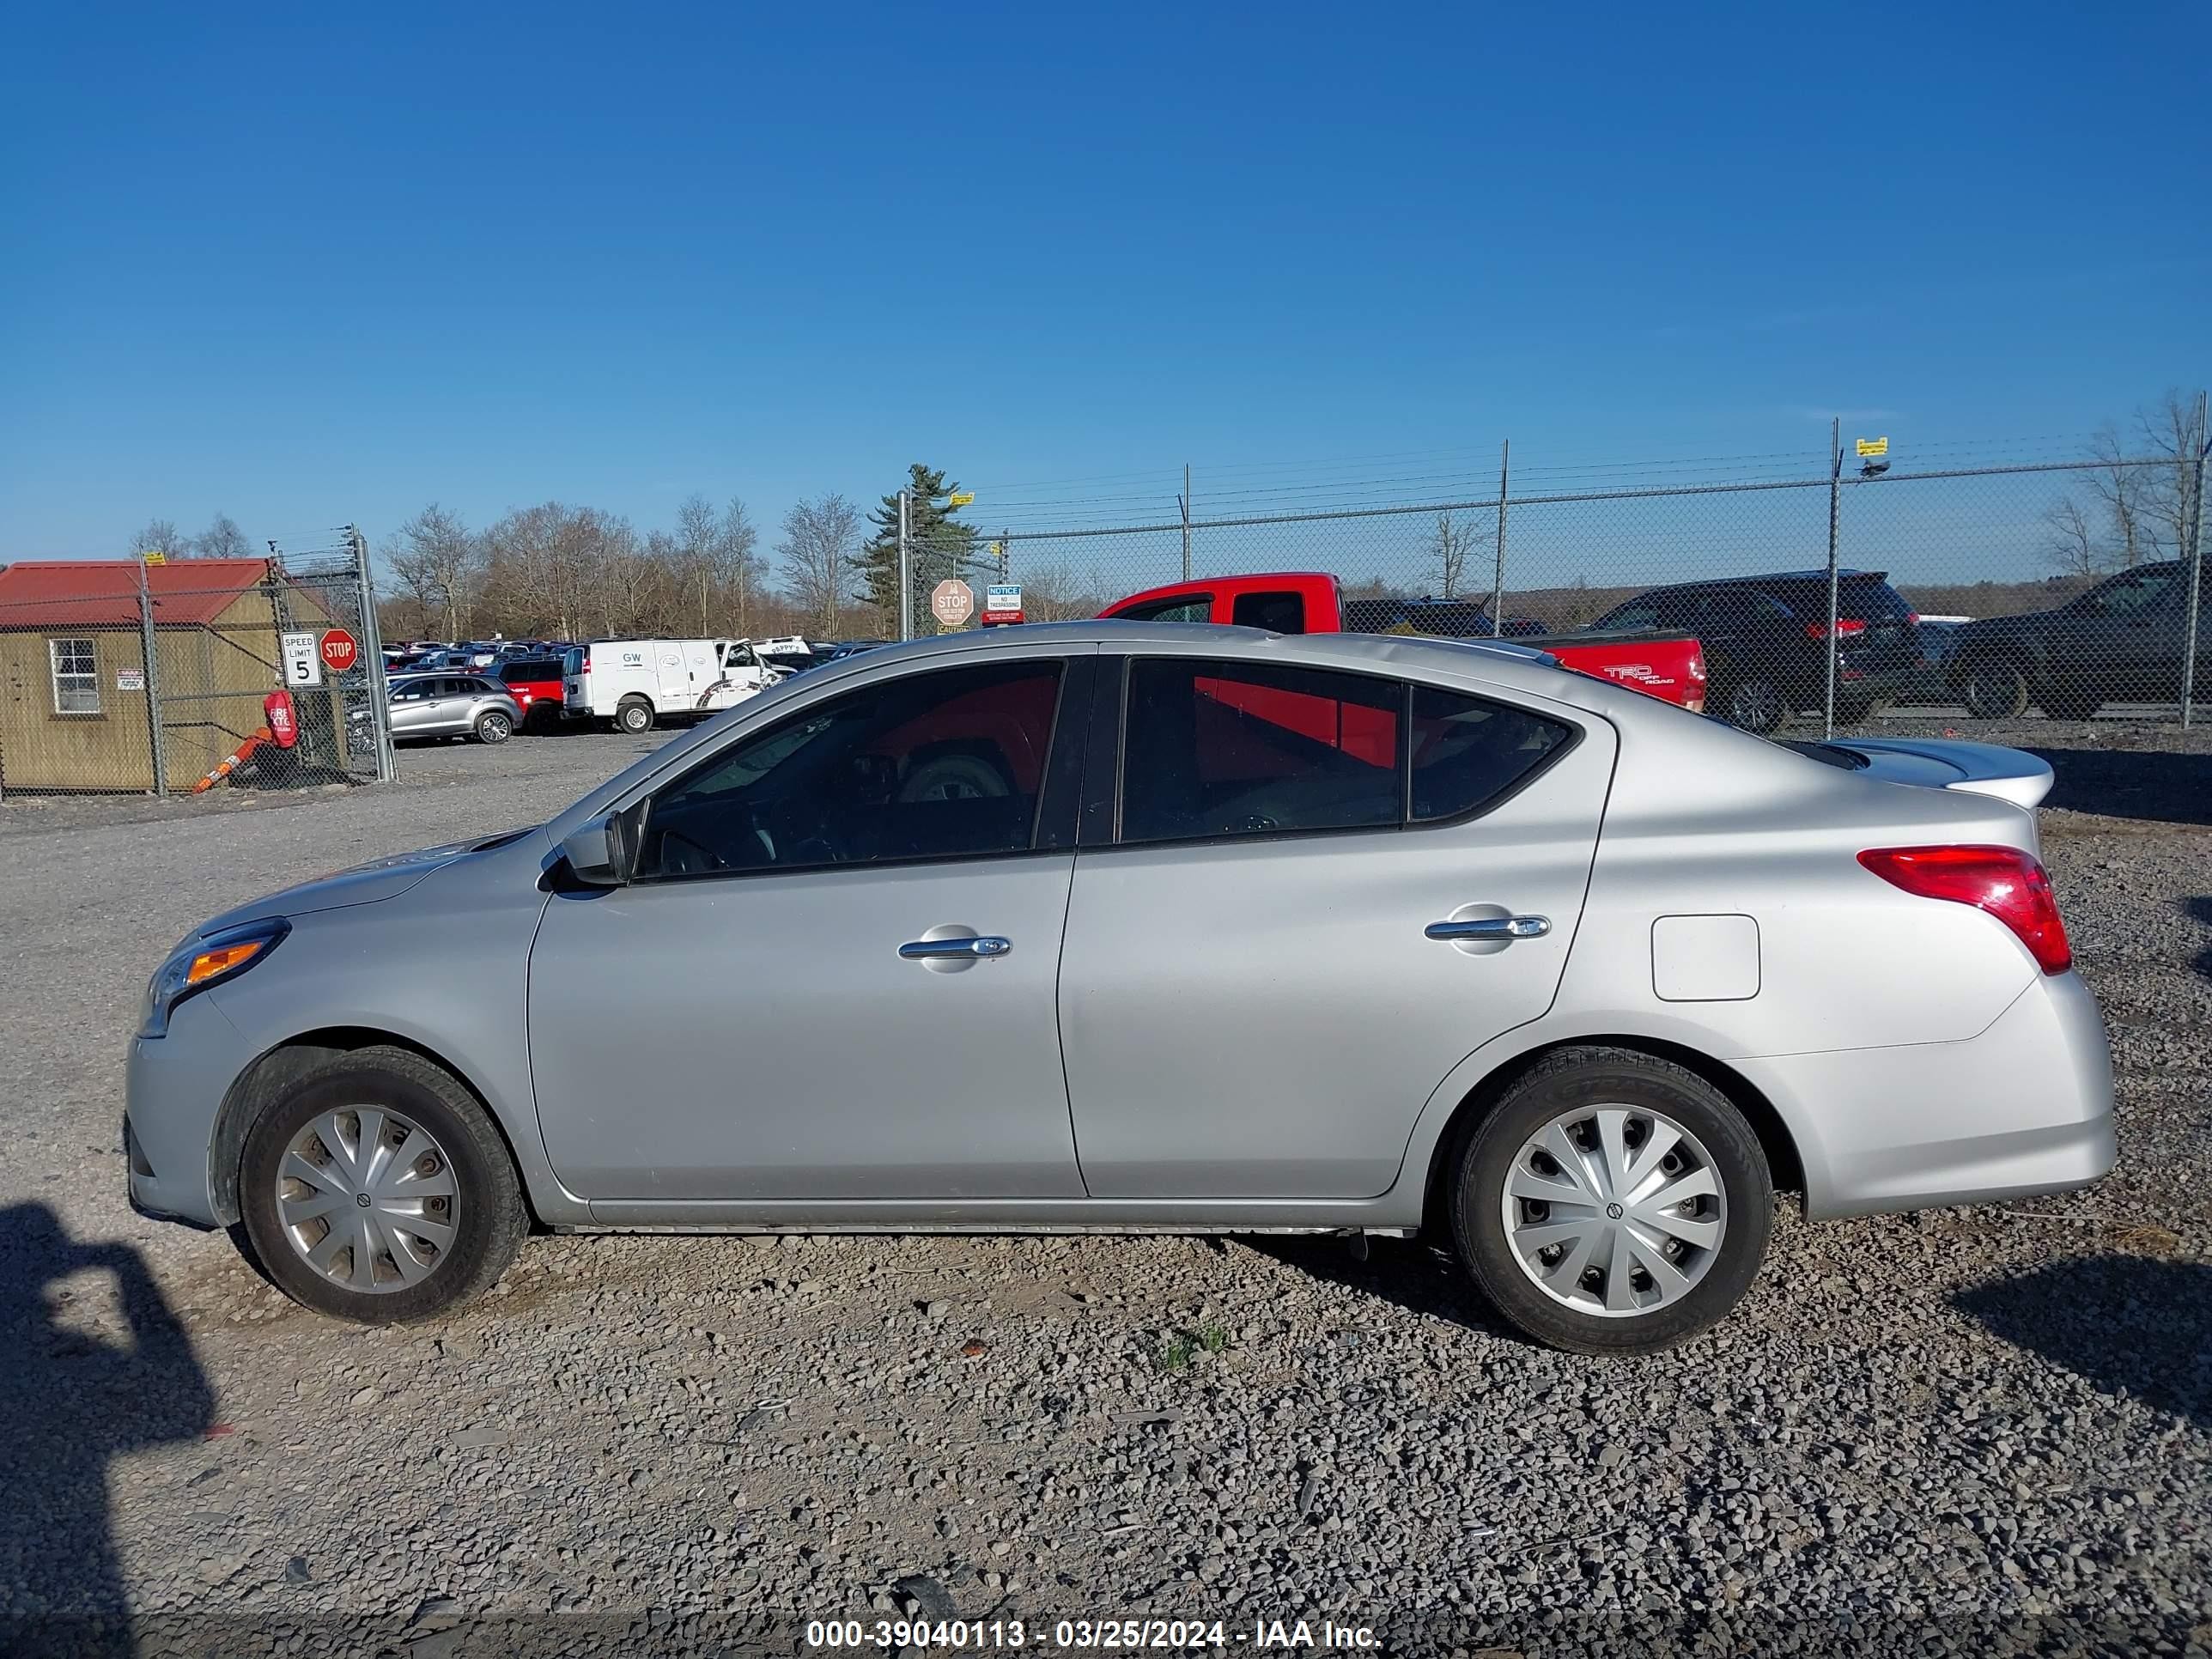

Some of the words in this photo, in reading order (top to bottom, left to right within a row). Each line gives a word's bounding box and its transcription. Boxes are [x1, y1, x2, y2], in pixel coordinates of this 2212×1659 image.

[938, 595, 968, 608] STOP
[285, 638, 313, 647] SPEED
[289, 649, 311, 658] LIMIT
[325, 641, 352, 658] STOP
[623, 653, 641, 662] GW
[296, 661, 310, 679] 5
[1603, 665, 1652, 680] TRD
[270, 708, 289, 719] FIRE
